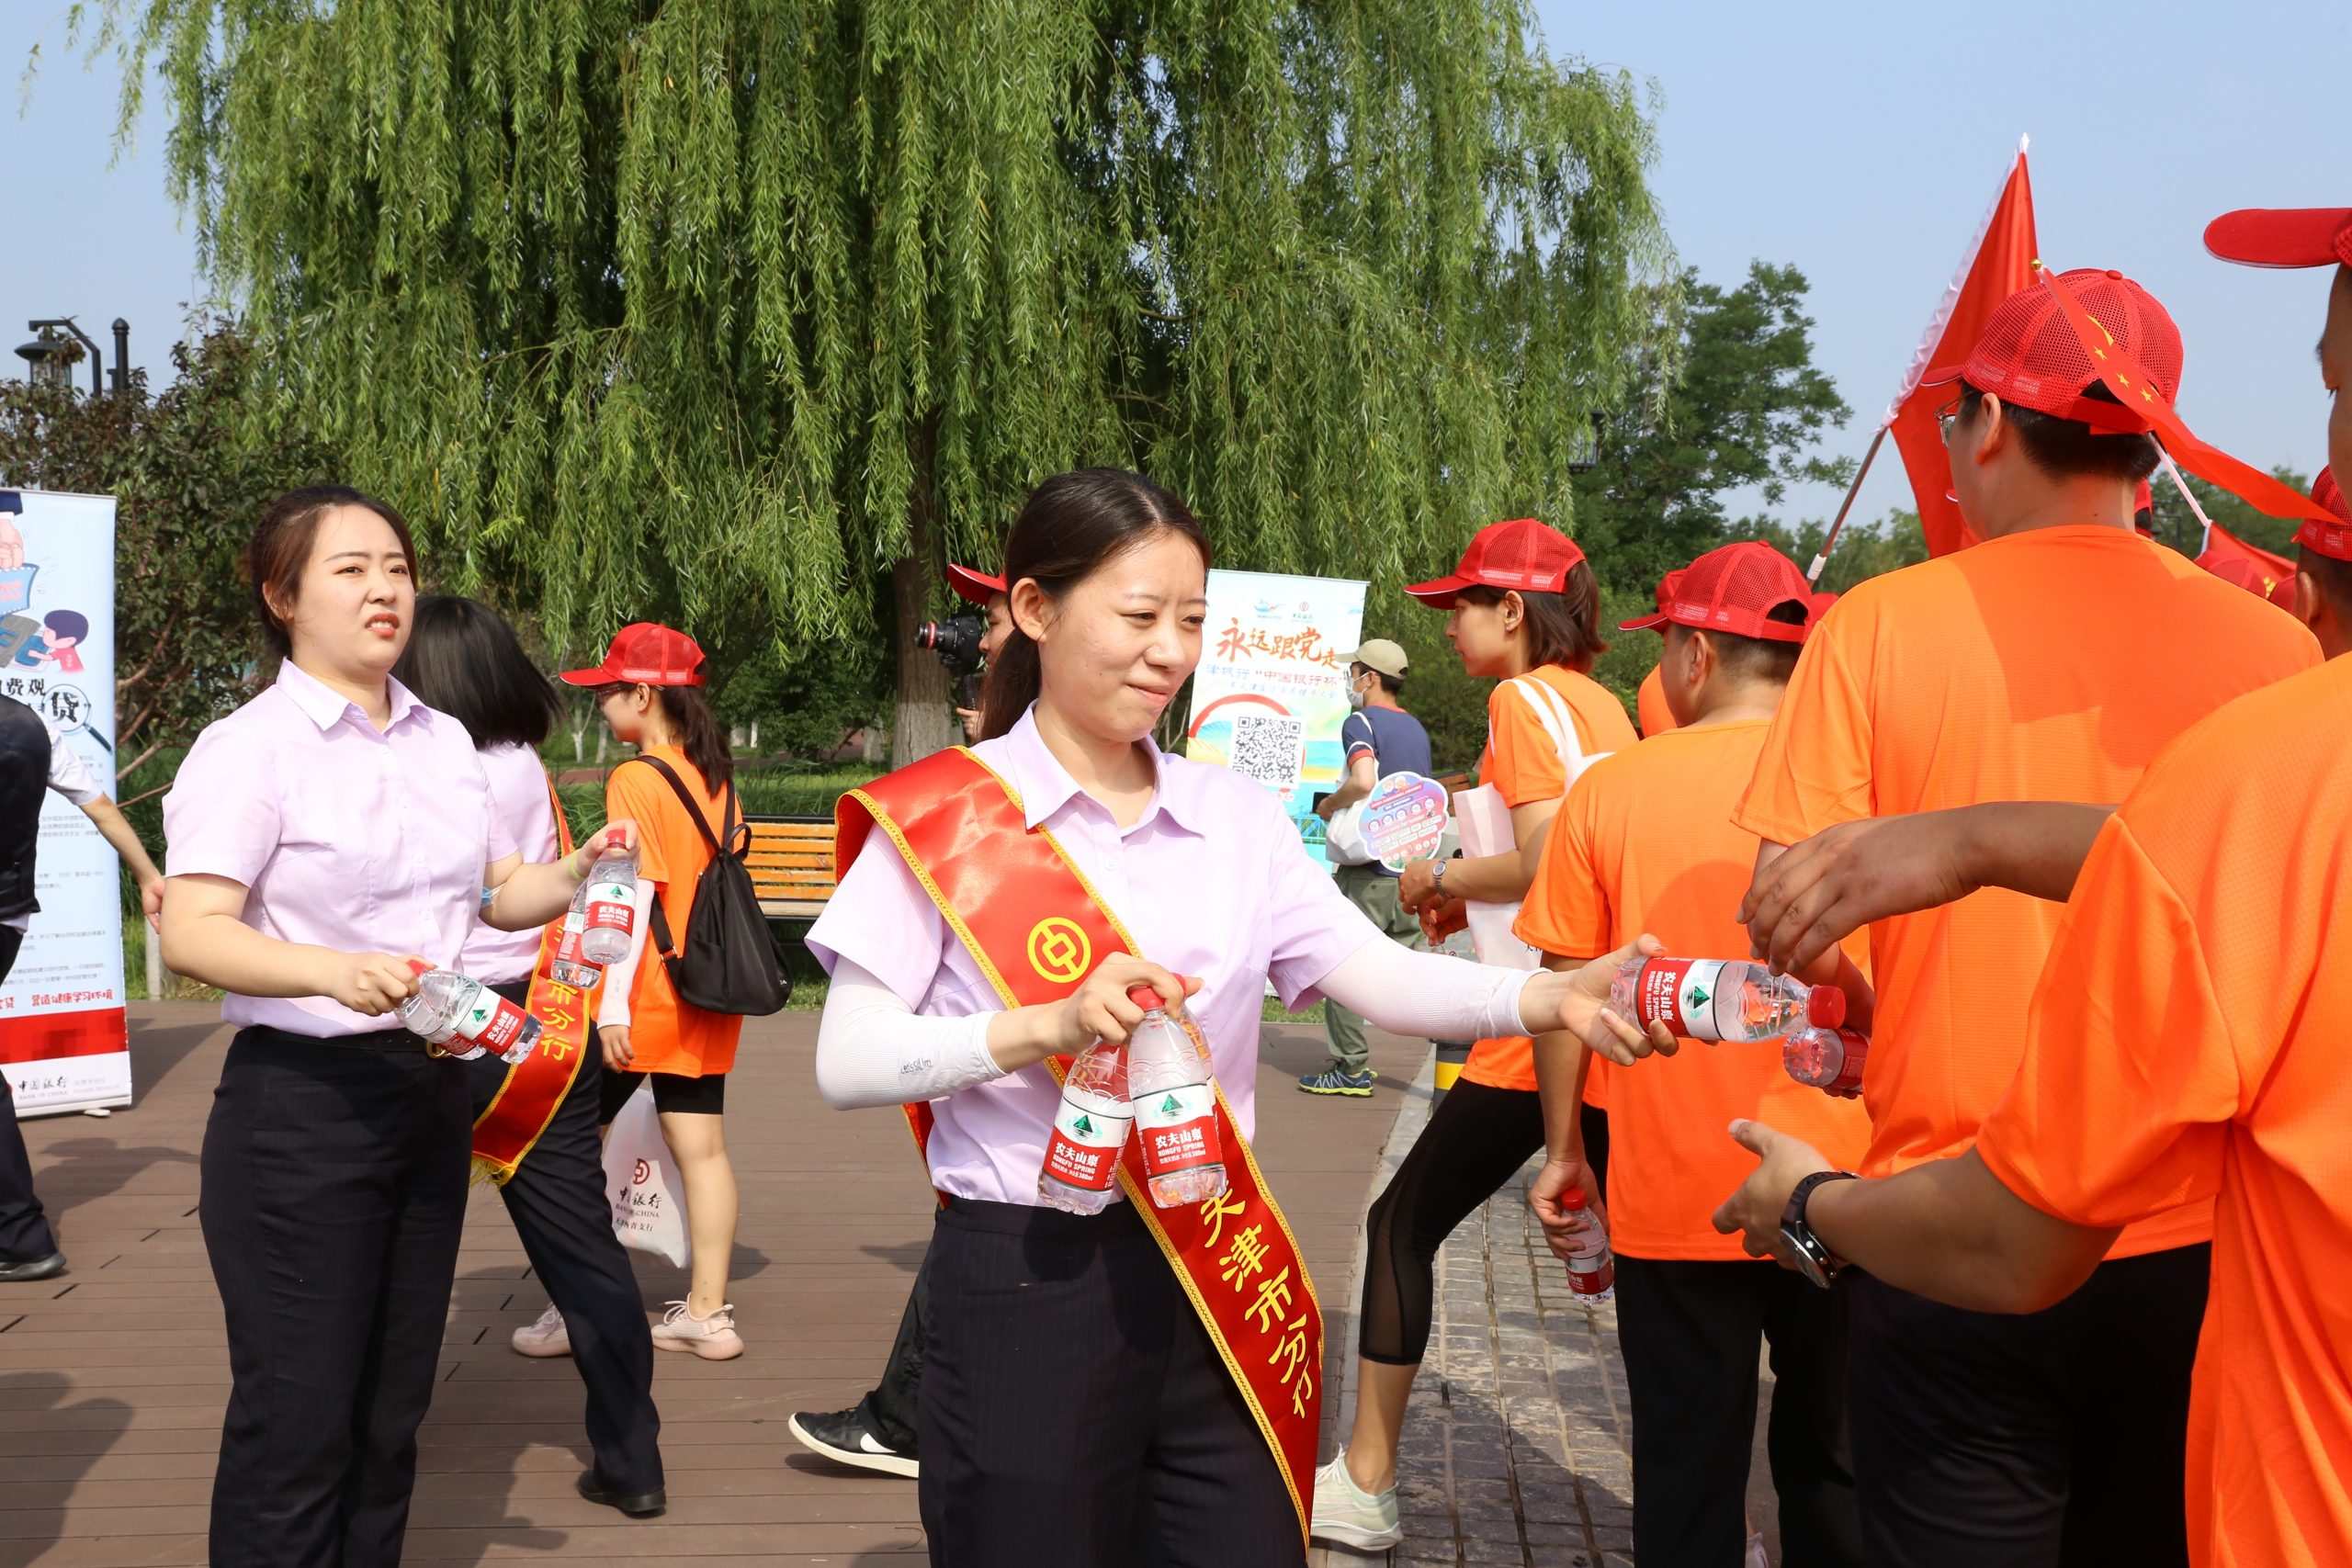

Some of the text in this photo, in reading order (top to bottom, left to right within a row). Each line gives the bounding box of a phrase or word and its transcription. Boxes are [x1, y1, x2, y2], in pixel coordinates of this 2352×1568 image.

[1216, 616, 1341, 671] 永远跟党走
[0, 677, 46, 696] 费观
[1660, 971, 1676, 1021] 农夫山泉
[1156, 1127, 1203, 1149] 农夫山泉
[1052, 1154, 1096, 1175] NONGFU SPRING
[1055, 1142, 1099, 1168] 农夫山泉
[1201, 1179, 1313, 1419] 天津市分行
